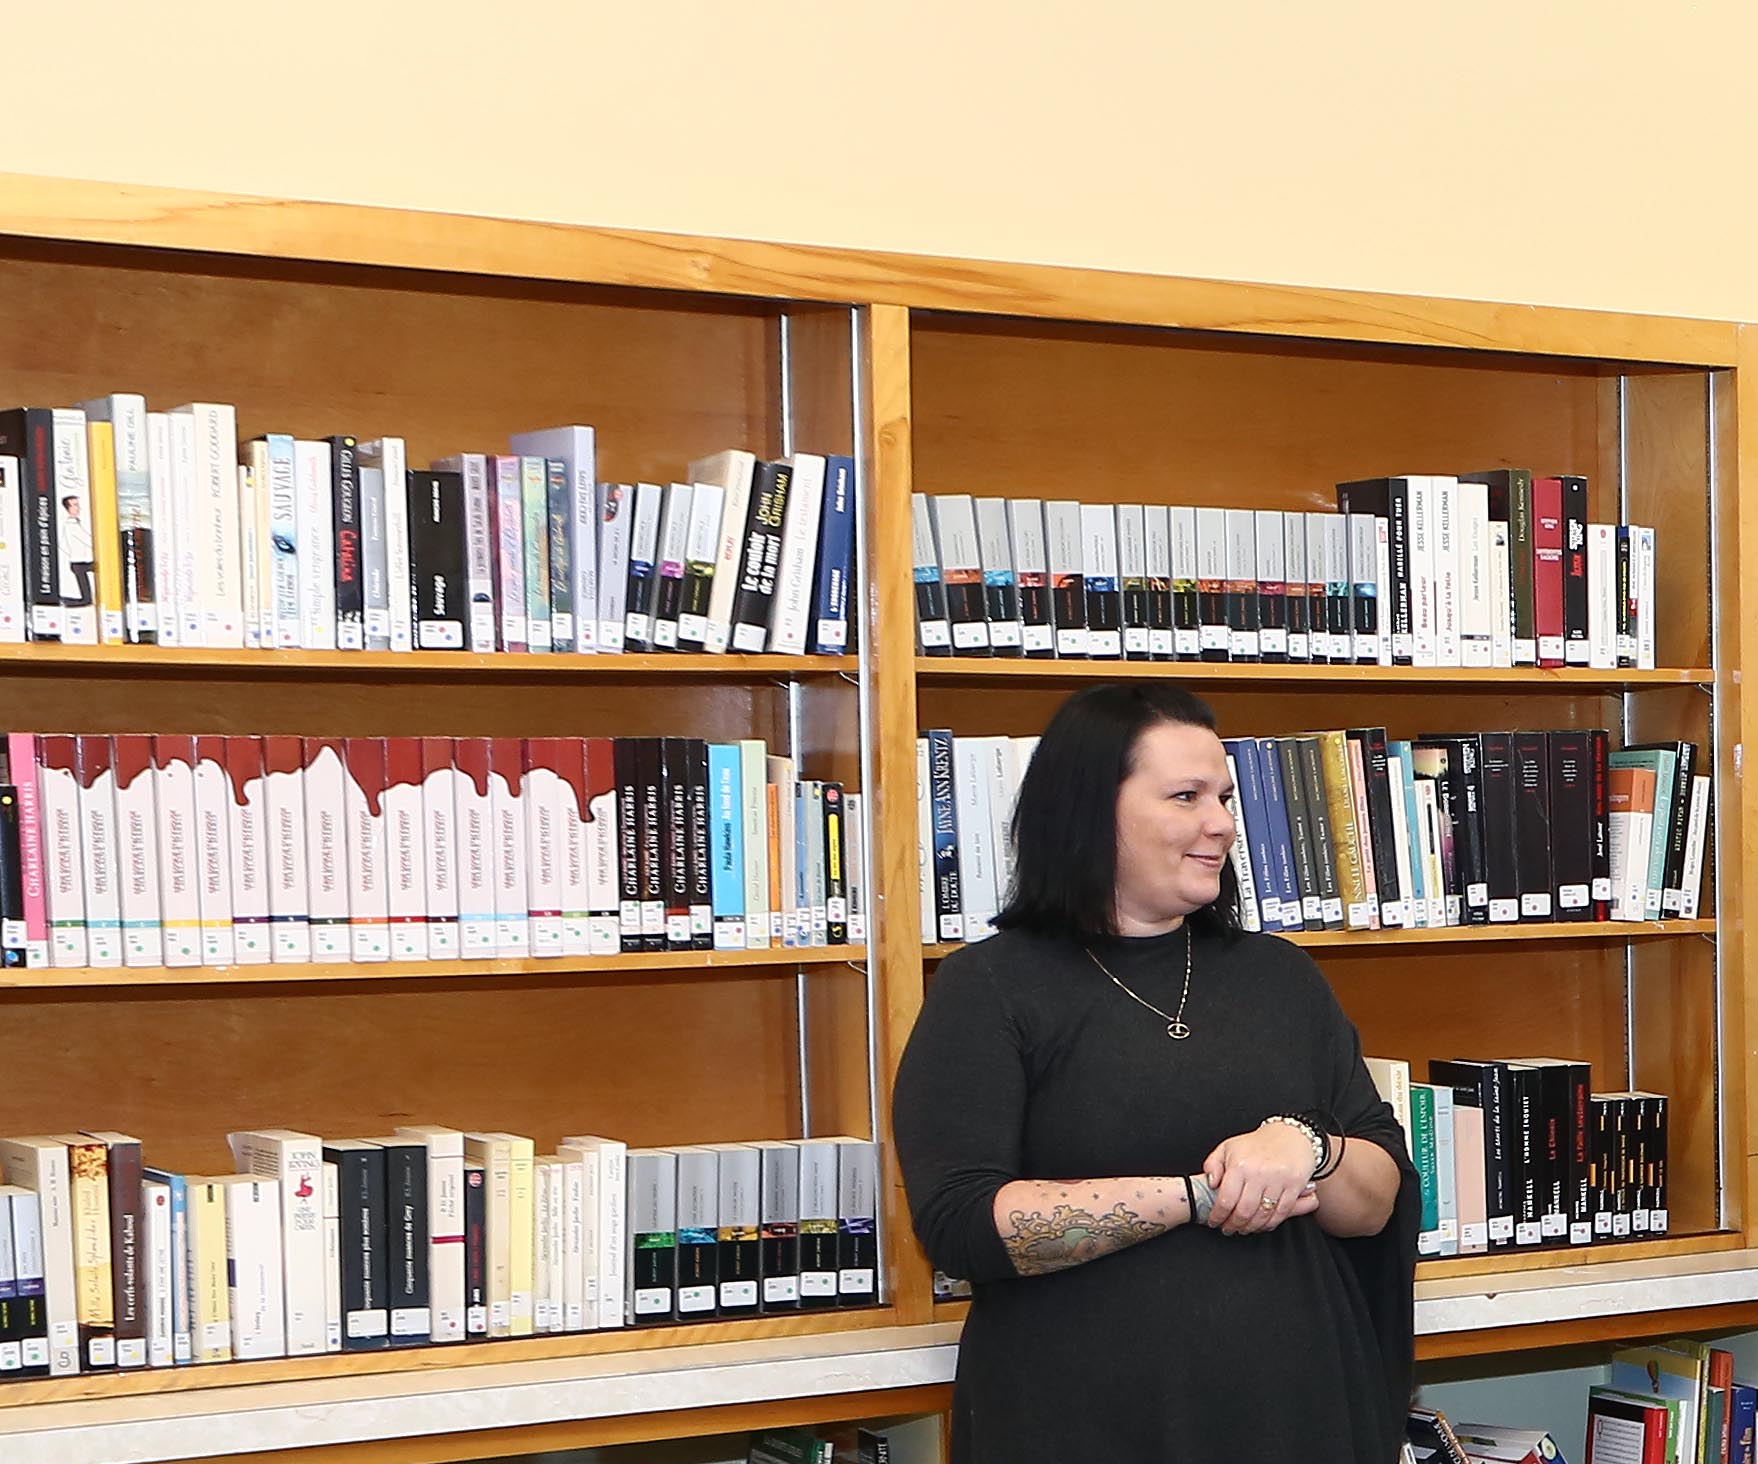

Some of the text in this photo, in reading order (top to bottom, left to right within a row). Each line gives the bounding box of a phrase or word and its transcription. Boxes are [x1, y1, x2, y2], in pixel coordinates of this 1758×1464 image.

[273, 457, 293, 520] SAUVAGE
[755, 492, 771, 525] JOHN
[768, 472, 789, 527] GRISHAM
[742, 531, 764, 591] Le couloir
[759, 534, 780, 594] de la mort
[1395, 543, 1405, 578] HABILLÉ
[1416, 532, 1426, 552] JESSE
[933, 736, 954, 834] JAYNE ANN KRENTZ
[22, 781, 40, 897] CHARLAINE HARRIS
[624, 785, 638, 895] CHARLAINE HARRIS
[647, 785, 660, 894] CHARLAINE HARRIS
[673, 784, 686, 893] CHARLAINE HARRIS
[696, 785, 707, 894] CHARLAINE HARRIS
[122, 1214, 135, 1244] Kaboul
[124, 1245, 134, 1255] de
[124, 1309, 135, 1320] Les
